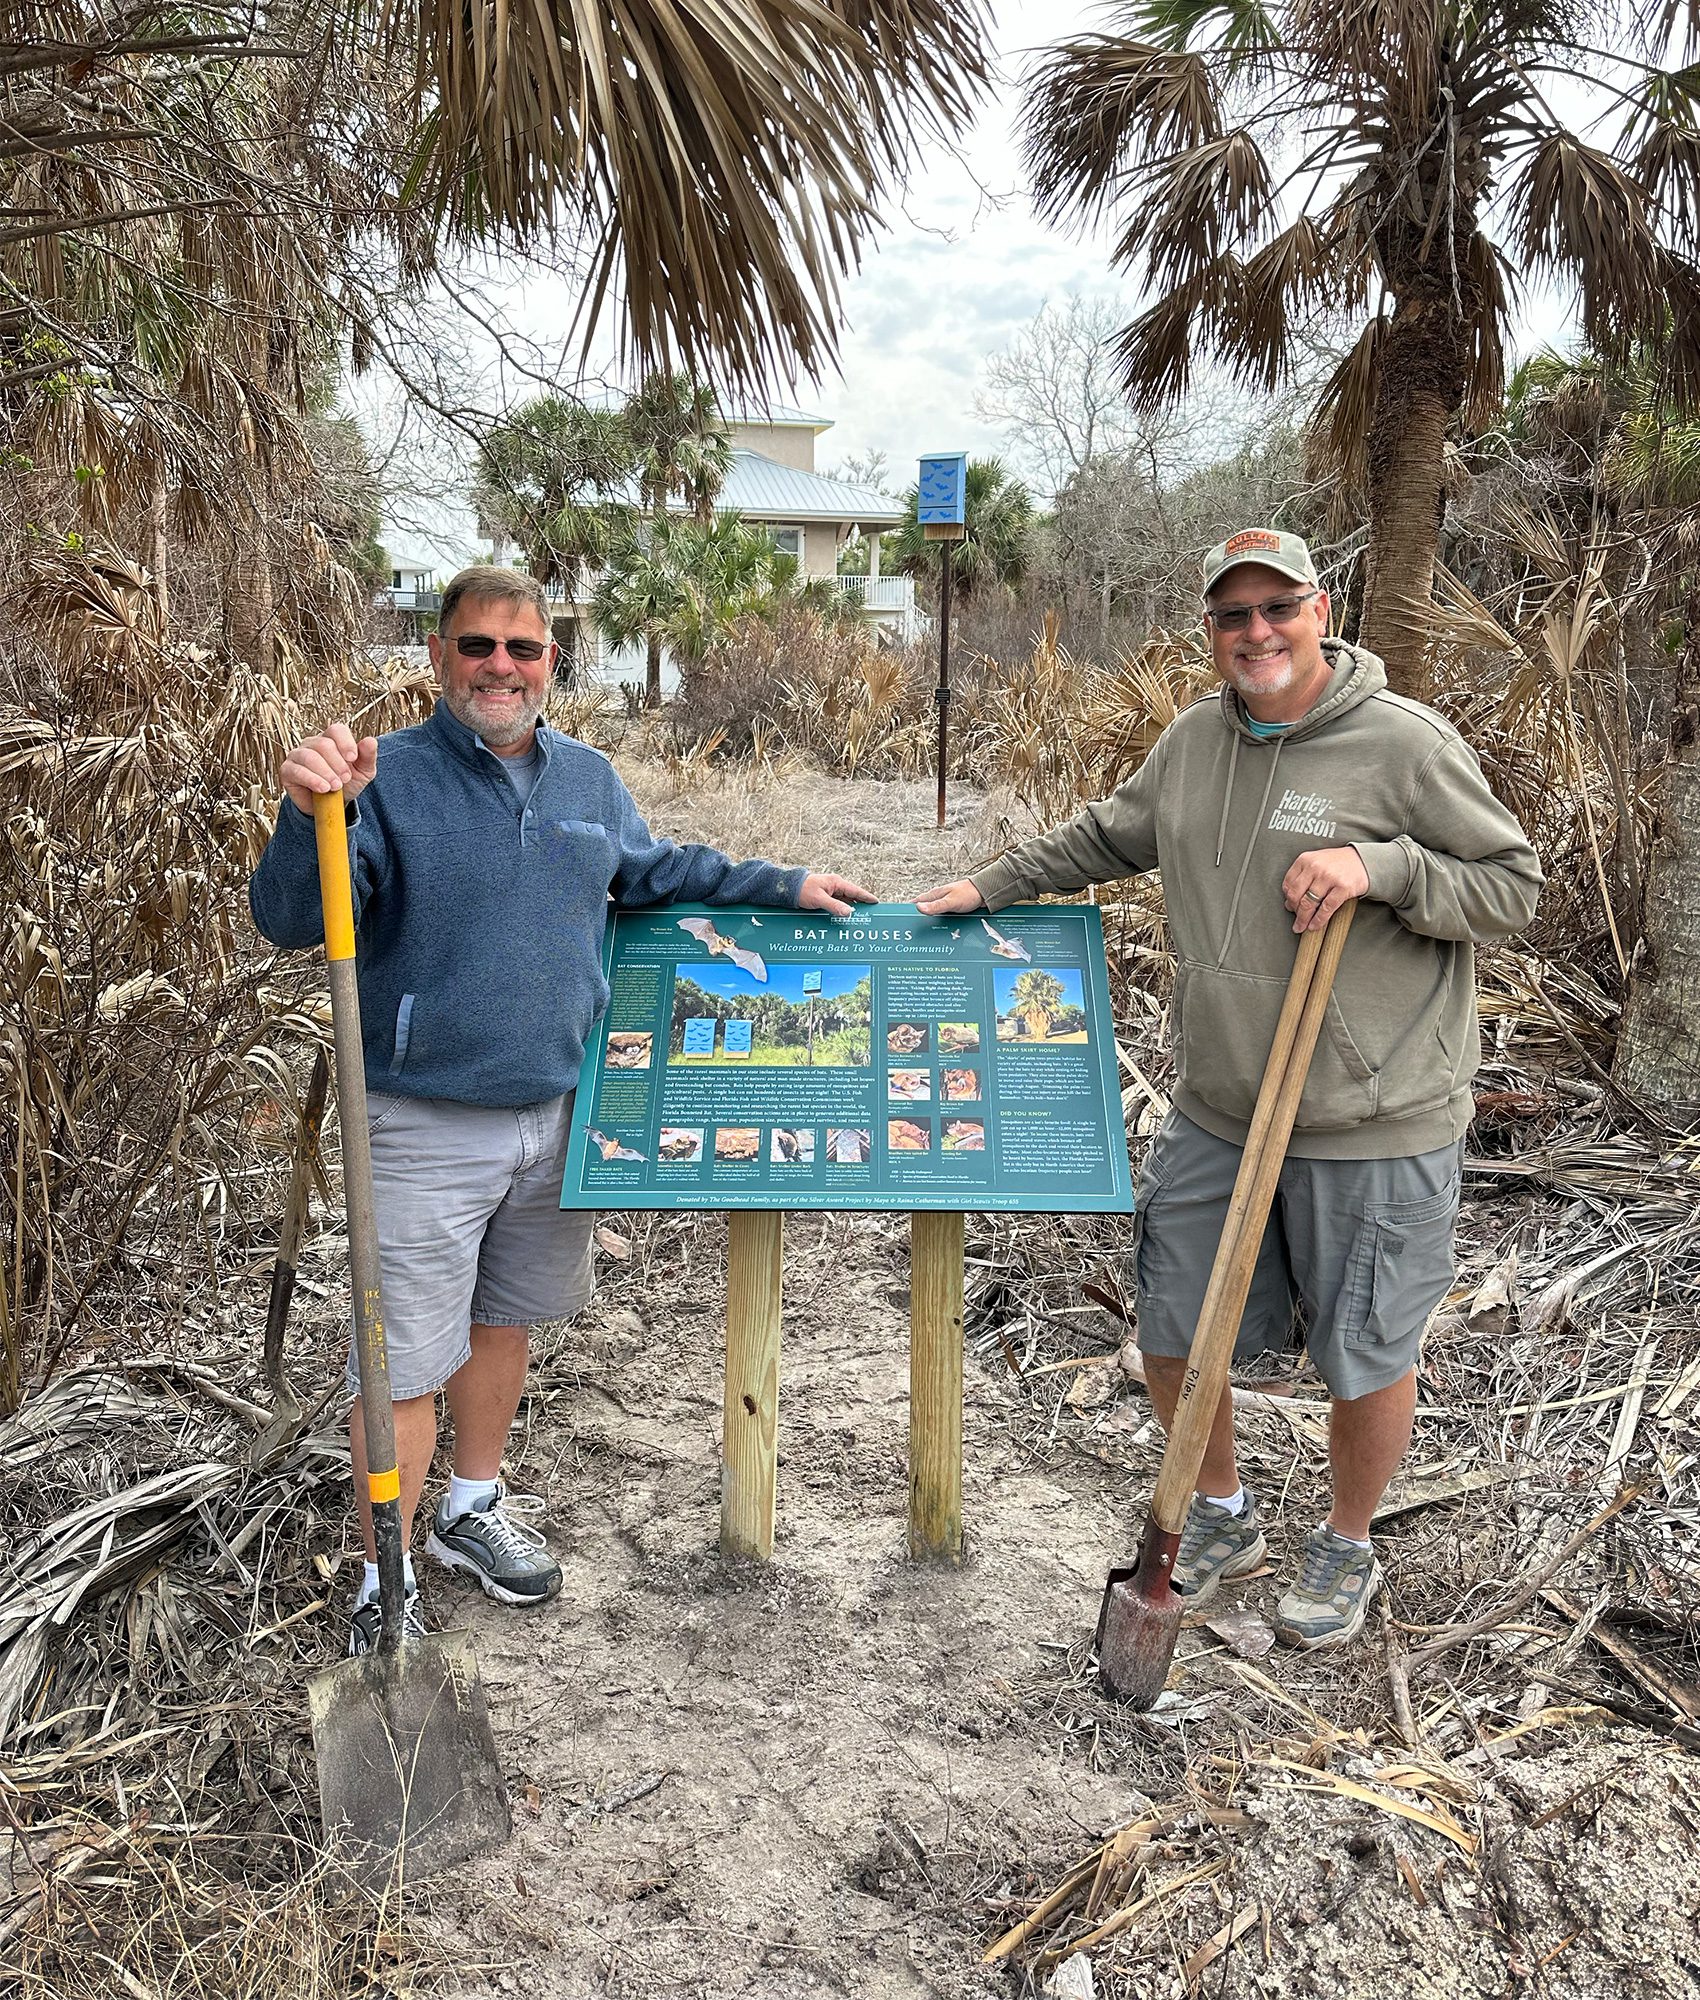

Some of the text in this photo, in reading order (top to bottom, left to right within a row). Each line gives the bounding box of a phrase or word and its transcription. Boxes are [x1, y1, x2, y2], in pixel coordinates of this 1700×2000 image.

[1278, 789, 1336, 817] Harley-
[1268, 808, 1337, 838] Davidson
[794, 929, 912, 940] BAT HOUSES
[769, 943, 954, 955] Welcoming Bats To Your Community
